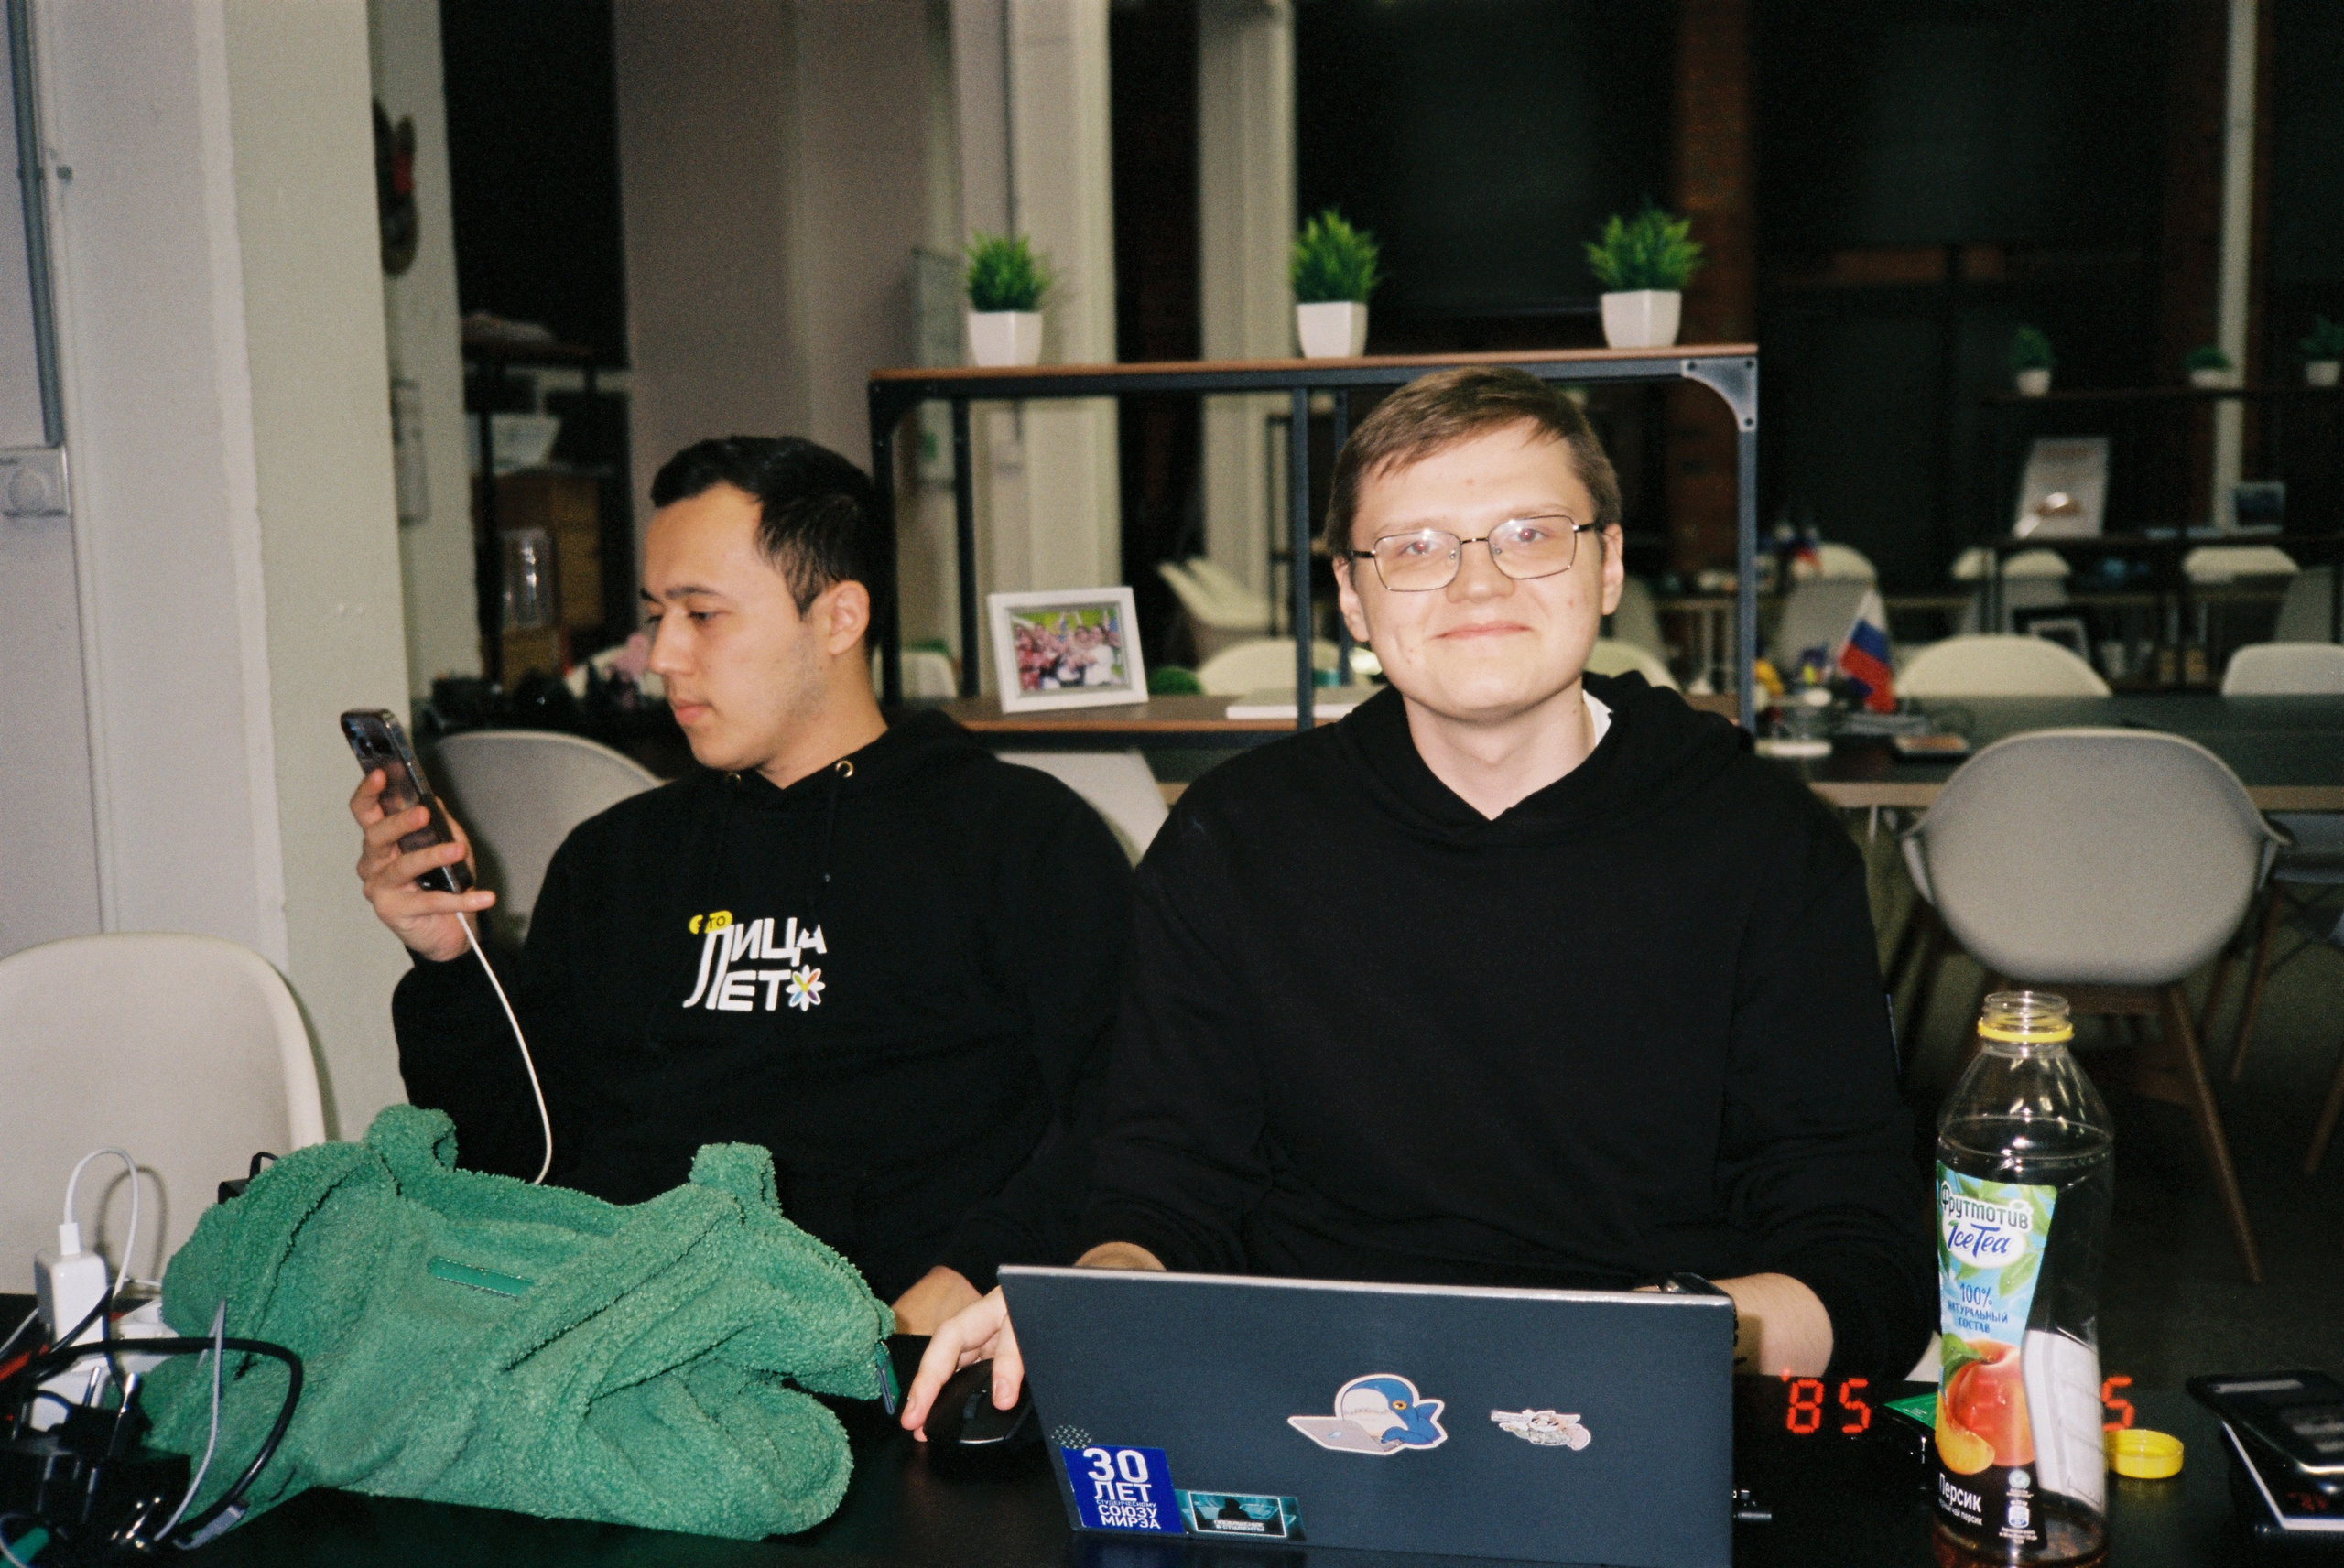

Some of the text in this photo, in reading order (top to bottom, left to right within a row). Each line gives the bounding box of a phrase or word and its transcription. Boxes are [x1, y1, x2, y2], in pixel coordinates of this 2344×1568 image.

[1959, 1283, 1993, 1308] 100%
[1947, 1300, 2008, 1324] НАТУРАЛЬНЫЙ
[1959, 1317, 1991, 1333] СОСТАВ
[1083, 1447, 1149, 1483] 30
[1093, 1480, 1153, 1503] ЛЕТ
[1939, 1472, 1982, 1513] Персик
[1098, 1504, 1157, 1519] СОЮЗУ
[1101, 1515, 1161, 1530] МИРЭА
